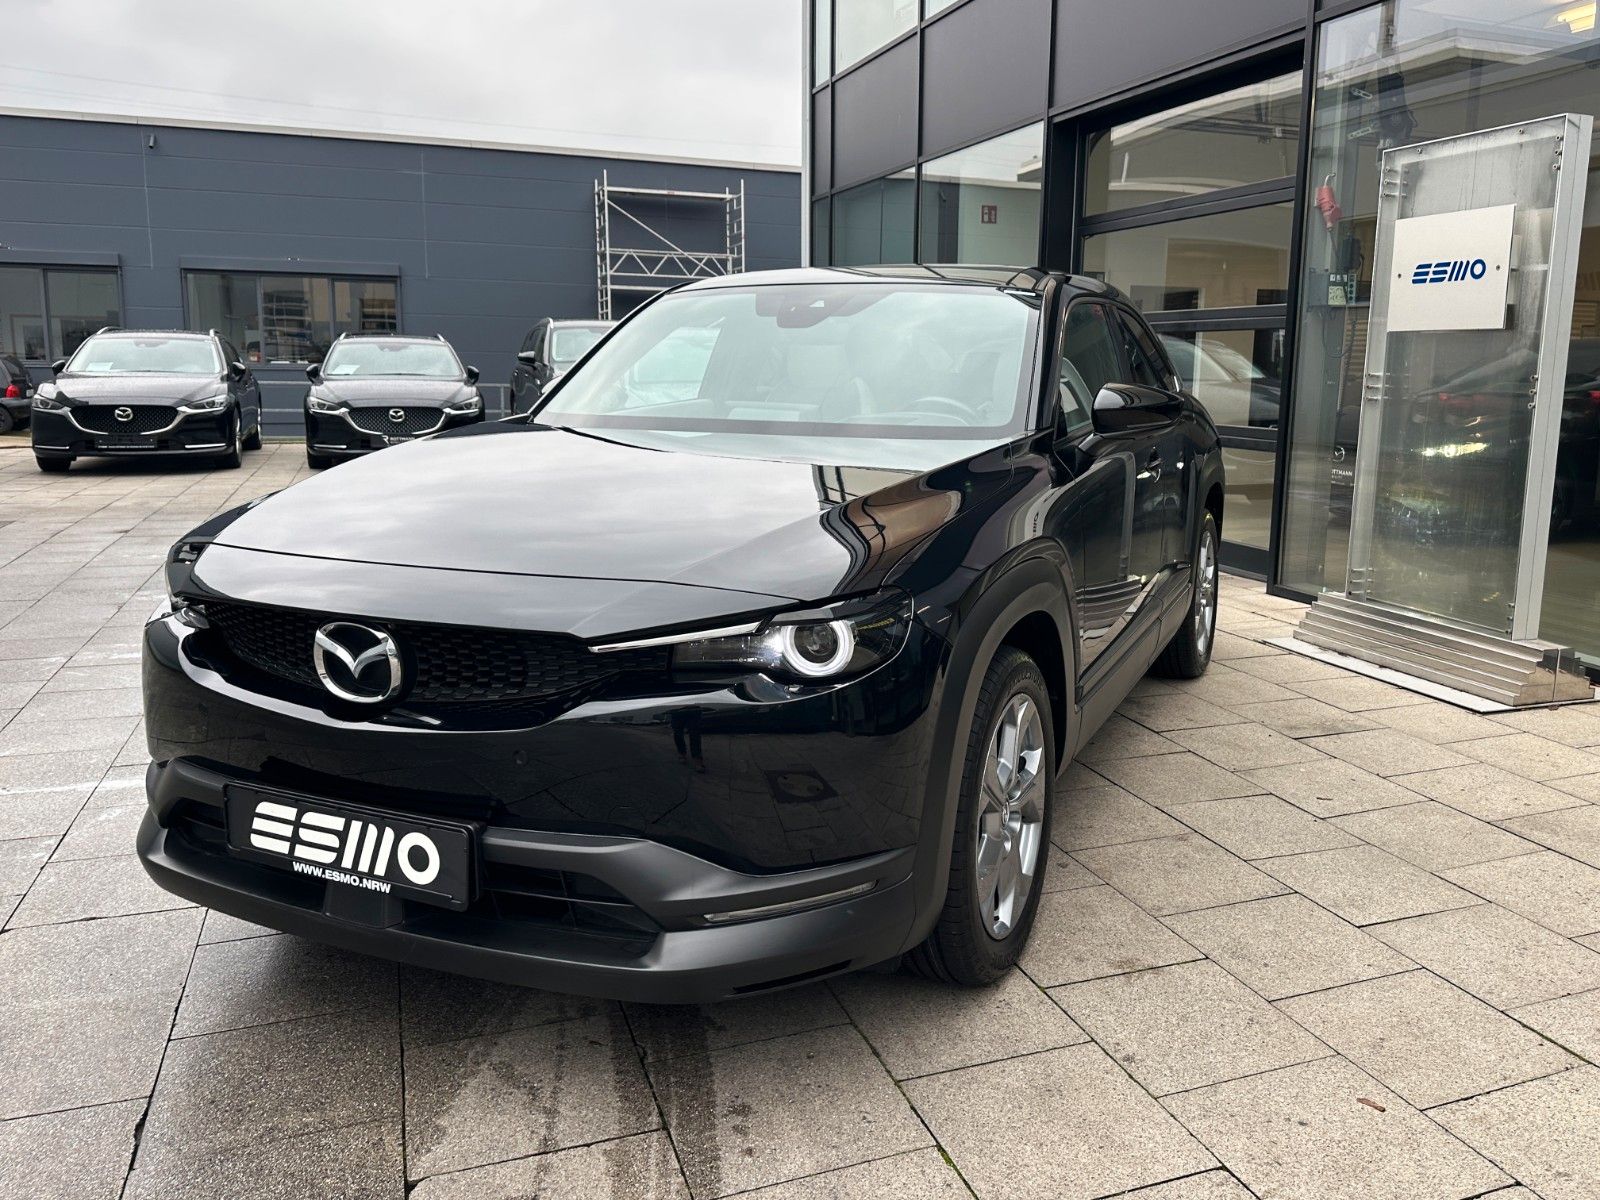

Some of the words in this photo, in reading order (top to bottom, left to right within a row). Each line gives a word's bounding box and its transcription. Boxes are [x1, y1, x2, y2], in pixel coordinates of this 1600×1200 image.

[1412, 259, 1486, 284] ESMO
[250, 801, 440, 885] ESMO
[292, 861, 391, 894] WWW.ESMO.NRW
